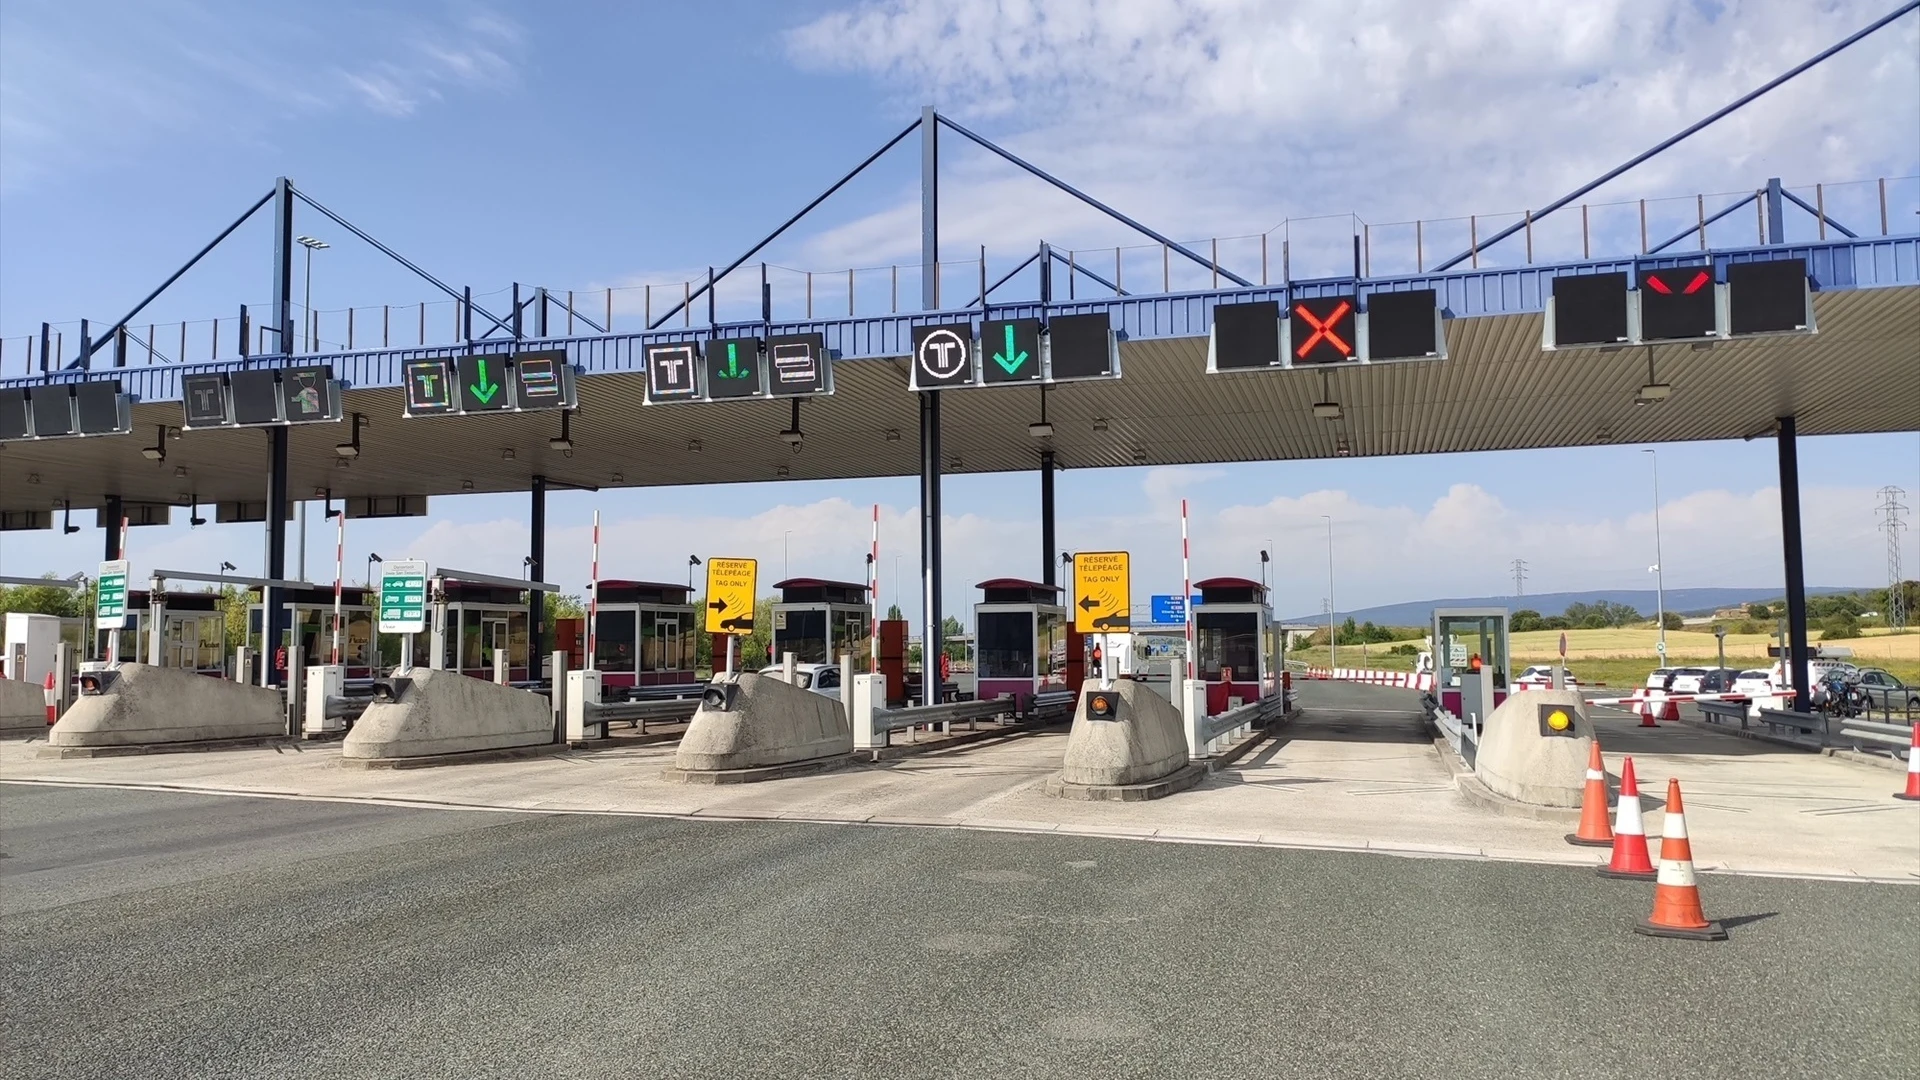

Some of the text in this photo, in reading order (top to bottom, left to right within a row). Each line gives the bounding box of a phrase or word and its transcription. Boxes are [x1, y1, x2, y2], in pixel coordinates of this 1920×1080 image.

[1100, 575, 1120, 583] ONLY
[715, 579, 748, 588] TAG ONLY
